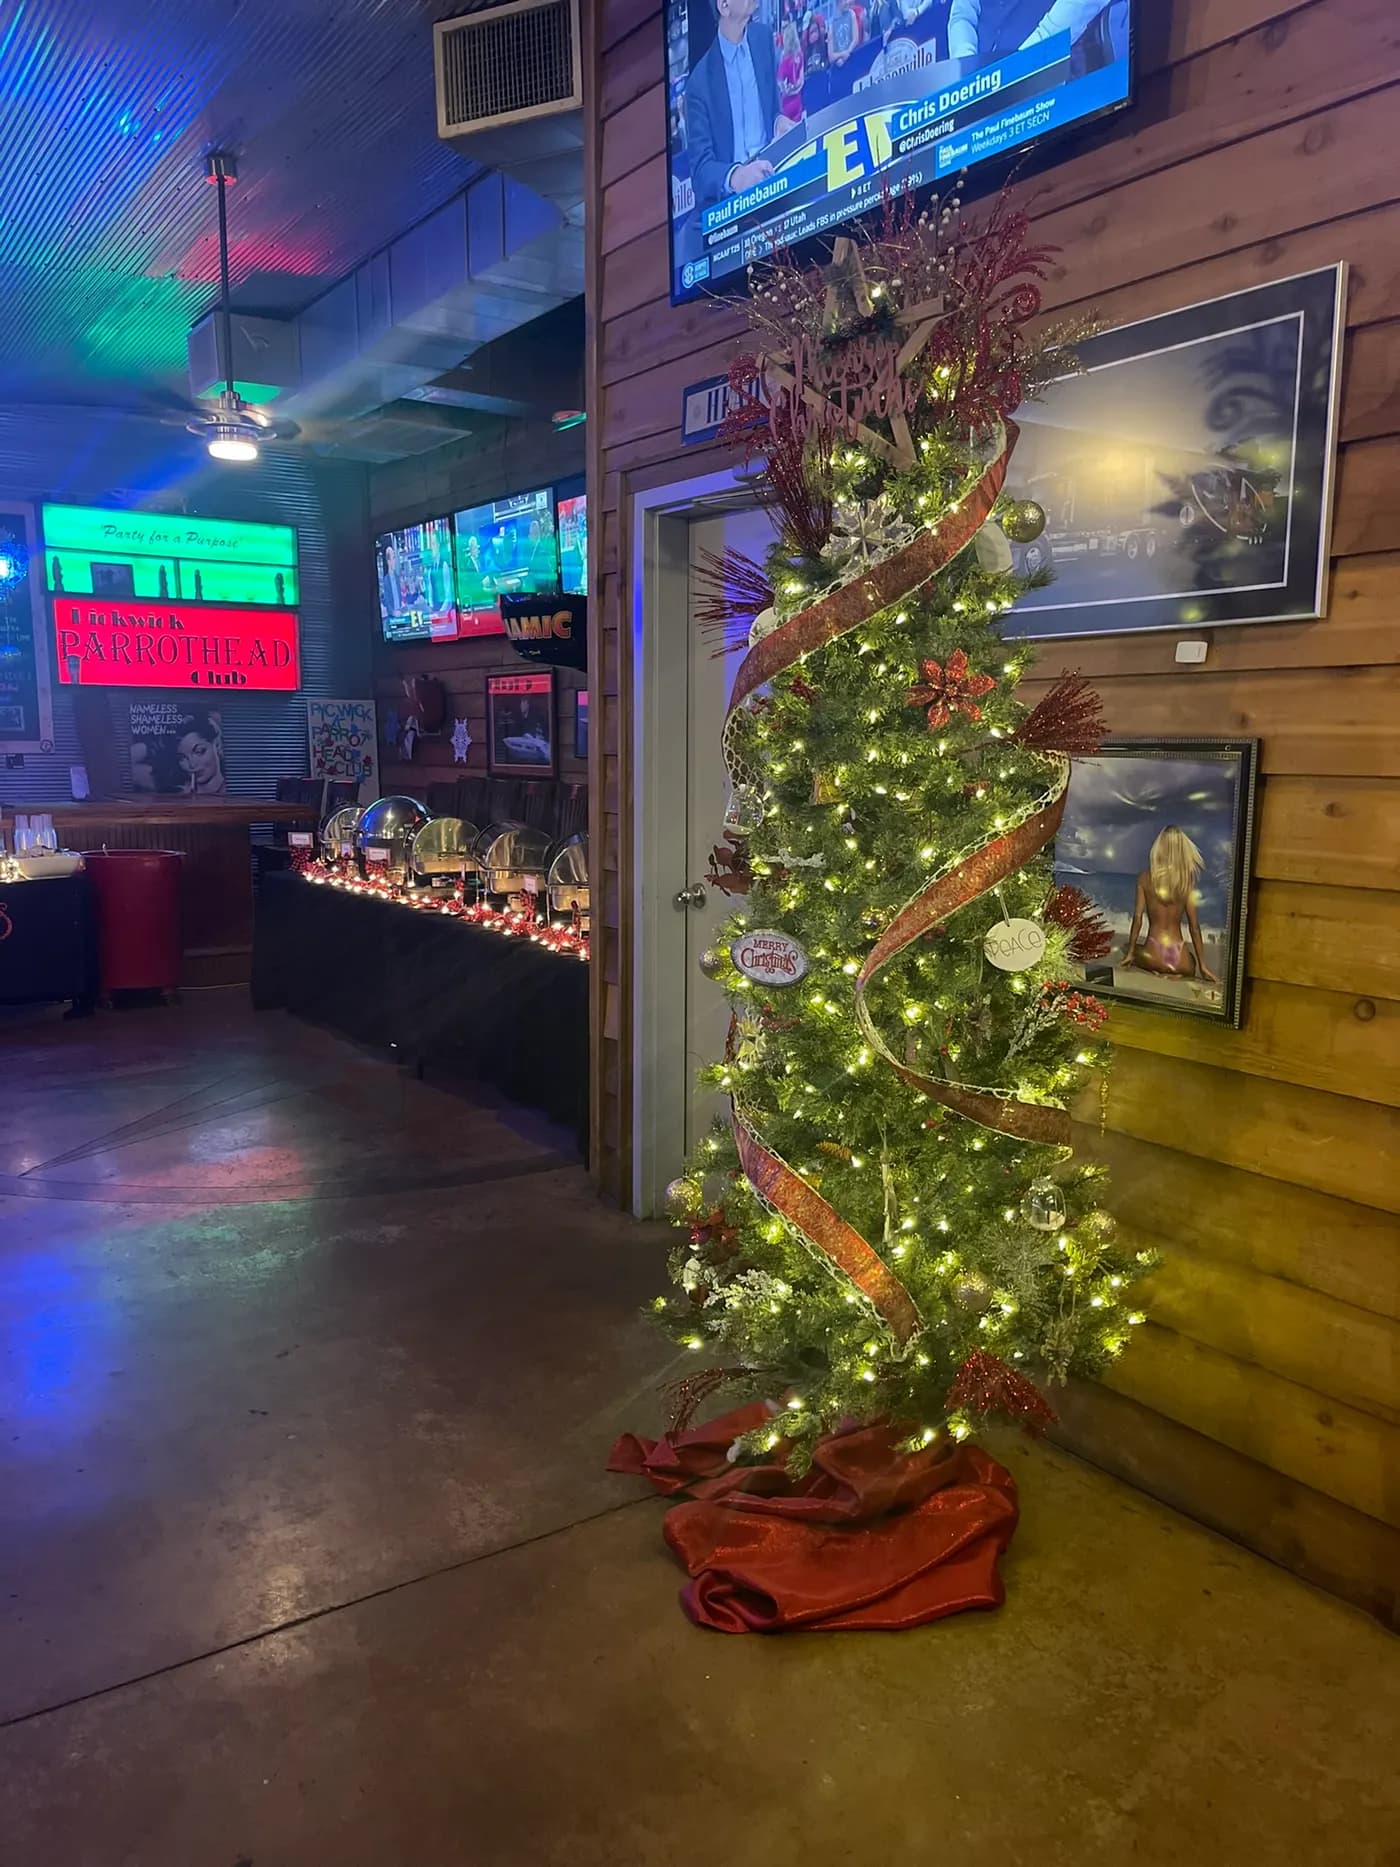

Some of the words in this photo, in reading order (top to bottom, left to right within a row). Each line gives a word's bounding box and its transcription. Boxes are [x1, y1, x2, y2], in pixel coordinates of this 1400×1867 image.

[900, 101, 936, 130] Chris
[939, 69, 1001, 111] Doering
[971, 131, 984, 142] The
[985, 122, 1000, 137] Paul
[1000, 108, 1035, 129] Finebaum
[1035, 98, 1056, 114] Show
[899, 118, 955, 152] @ChrisDoering
[971, 131, 1008, 154] Weekdays
[1015, 122, 1025, 135] ET
[1027, 112, 1051, 129] SECN
[862, 181, 872, 193] ET
[707, 202, 732, 227] Paul
[733, 177, 788, 214] Finebaum
[790, 211, 807, 228] Utah
[799, 220, 816, 236] Leads
[816, 214, 829, 228] FBS
[149, 530, 169, 545] for
[173, 535, 182, 544] a
[59, 630, 292, 668] PARROTHEAD
[190, 670, 247, 685] Club
[130, 703, 178, 714] NAMELESS
[130, 714, 184, 724] SHAMELESS
[334, 760, 373, 777] CLUB
[753, 938, 789, 952] MERRY
[740, 947, 799, 976] Christmas
